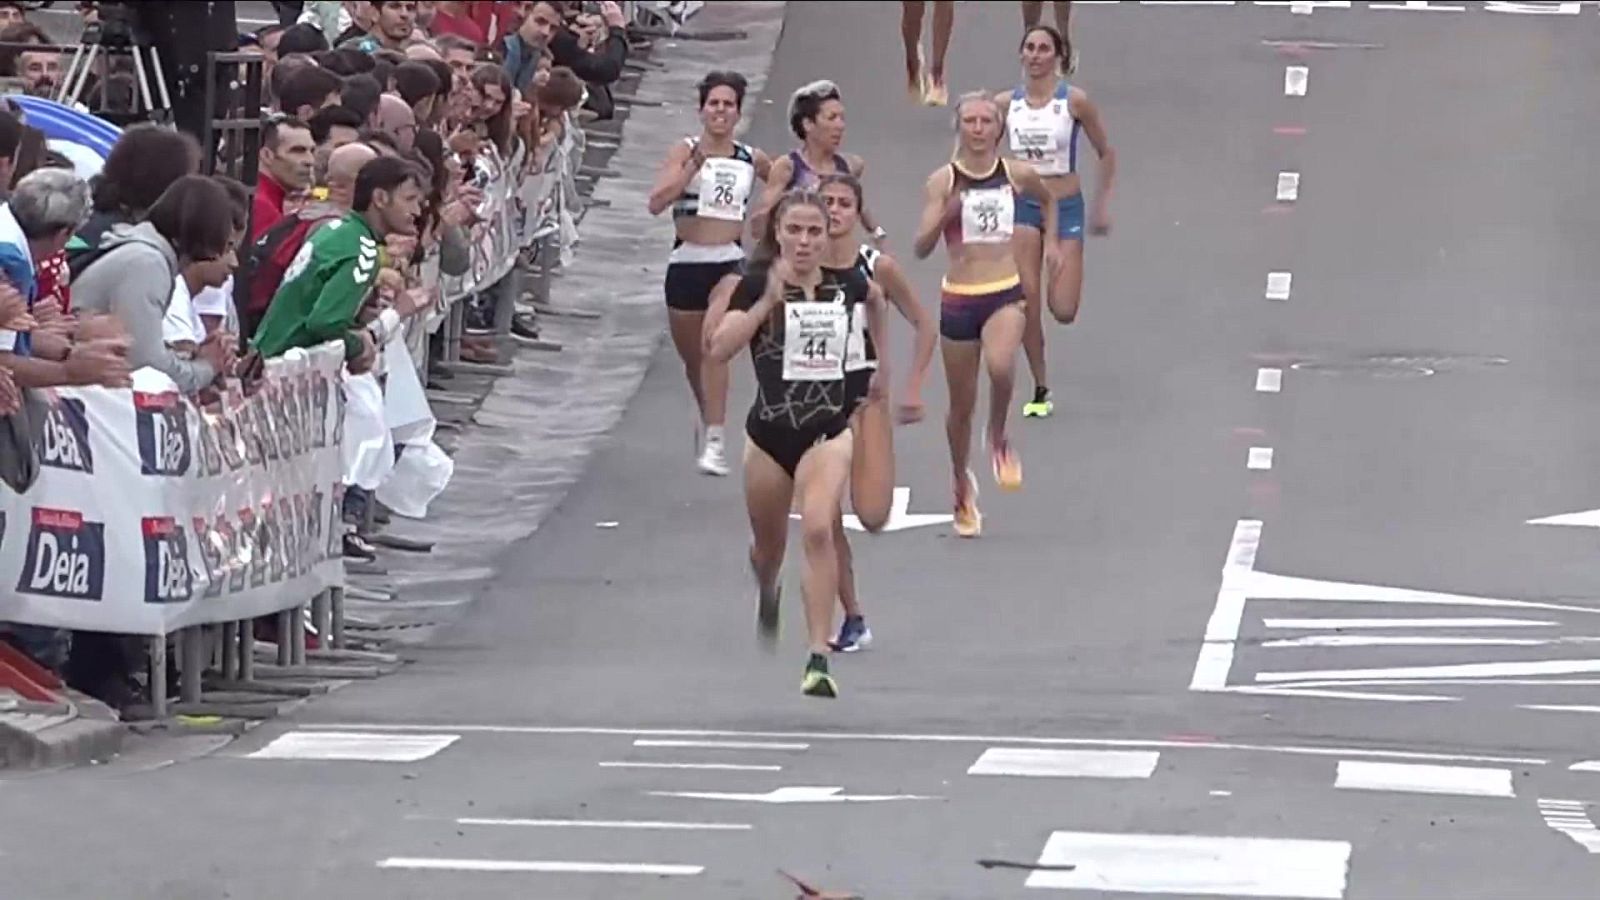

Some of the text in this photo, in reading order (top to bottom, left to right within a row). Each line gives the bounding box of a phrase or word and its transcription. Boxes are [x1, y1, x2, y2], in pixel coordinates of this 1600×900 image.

[714, 186, 733, 204] 26
[978, 212, 999, 232] 33
[803, 337, 827, 360] 44
[30, 532, 90, 594] Deia
